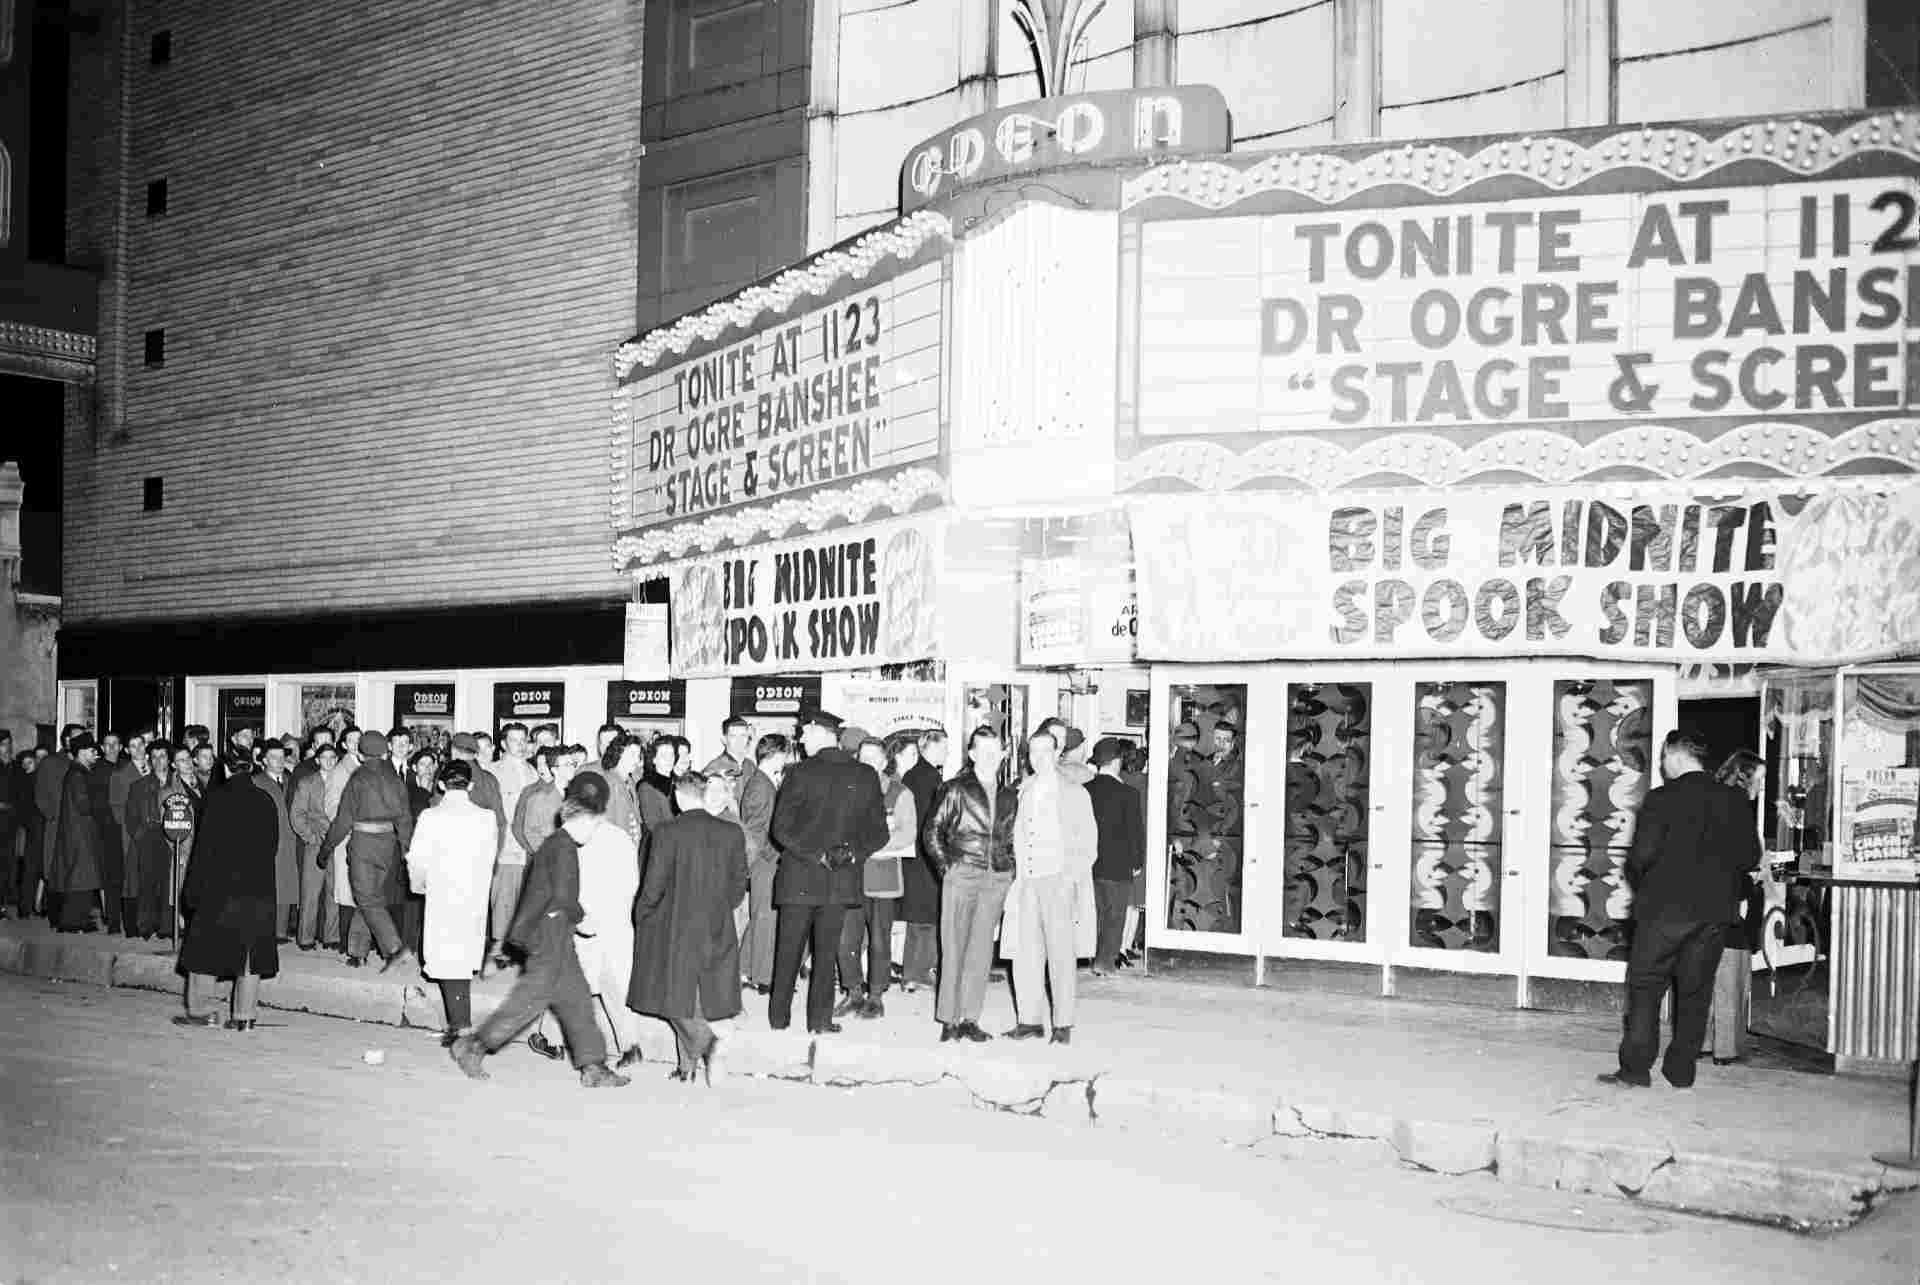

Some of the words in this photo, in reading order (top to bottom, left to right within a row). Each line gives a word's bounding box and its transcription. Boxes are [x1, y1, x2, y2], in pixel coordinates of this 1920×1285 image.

[1294, 209, 1581, 284] TONITE
[1626, 199, 1729, 271] AT
[1261, 293, 1364, 357] DR
[1410, 279, 1619, 349] OGRE
[674, 344, 755, 415] TONITE
[770, 326, 801, 382] AT
[1608, 352, 1659, 413] &
[649, 424, 675, 471] DR
[687, 401, 745, 459] OGRE
[757, 355, 880, 440] BANSHEE
[743, 450, 759, 497] &
[774, 537, 877, 604] MIDNITE
[1328, 504, 1451, 574] BIG
[1498, 499, 1778, 573] MIDNITE
[807, 601, 880, 658] SHOW
[1328, 574, 1575, 646] SPOOK
[1599, 580, 1785, 649] SHOW
